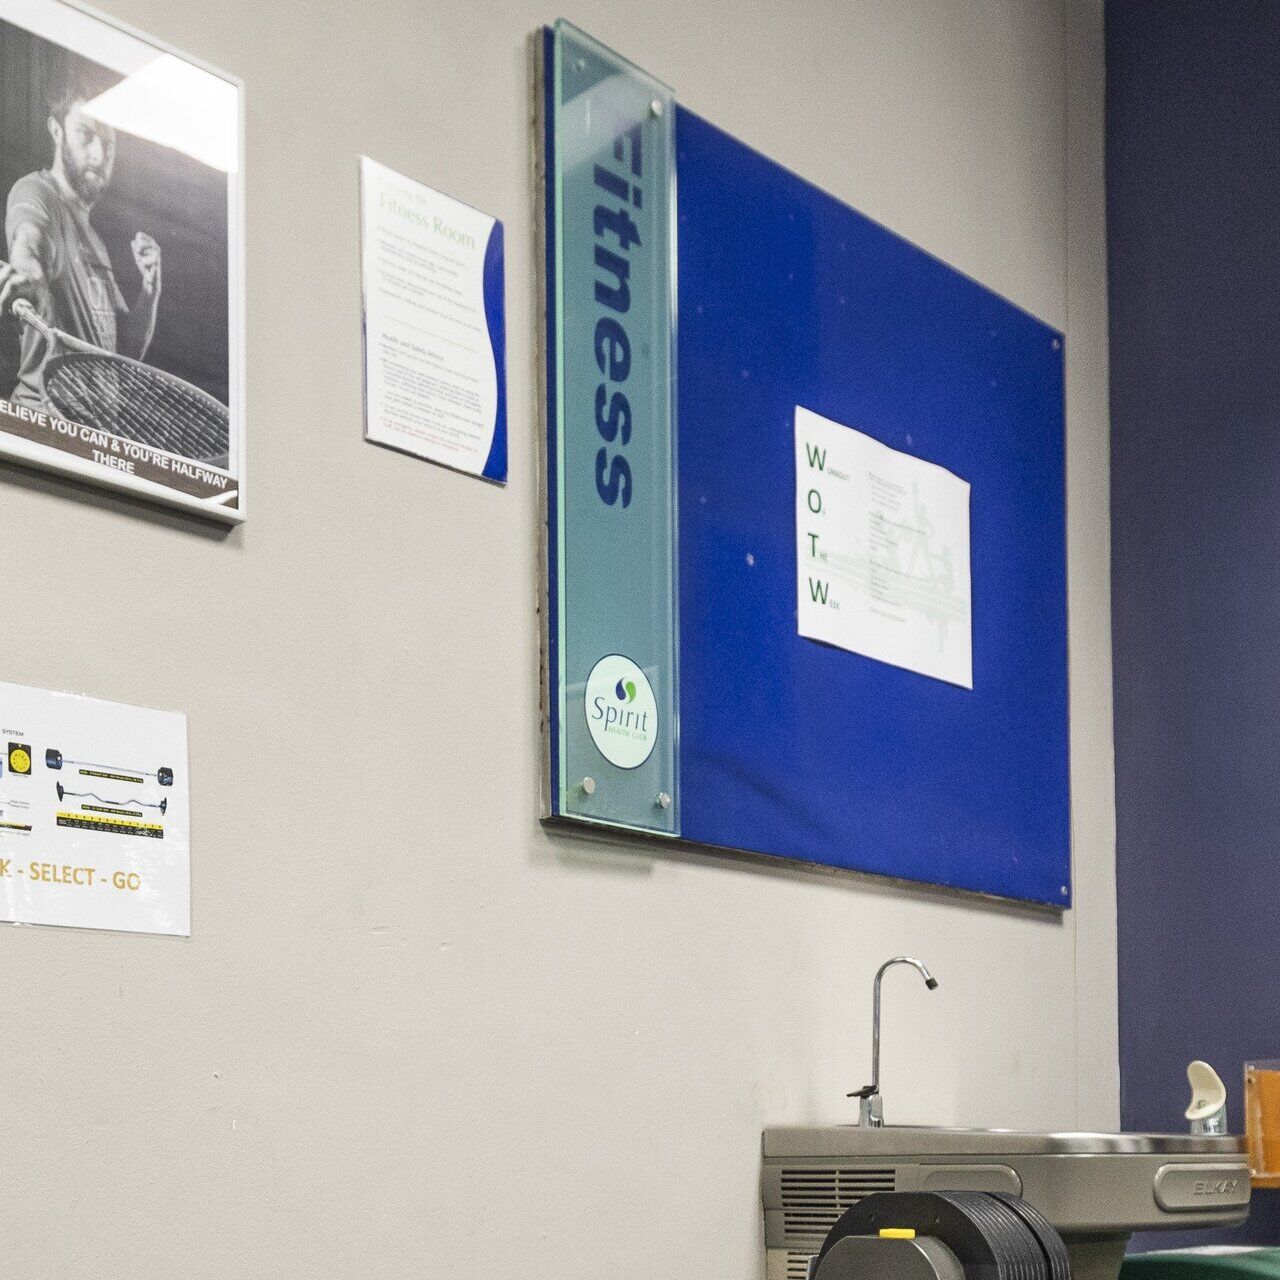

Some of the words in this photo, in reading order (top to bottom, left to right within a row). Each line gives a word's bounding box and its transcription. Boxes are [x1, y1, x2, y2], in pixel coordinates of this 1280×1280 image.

[433, 216, 476, 250] Room
[593, 121, 643, 509] Fitness
[49, 416, 77, 438] YOU
[80, 428, 108, 448] CAN
[111, 440, 120, 453] &
[123, 442, 169, 470] YOU'RE
[171, 459, 228, 489] HALFWAY
[92, 450, 135, 474] THERE
[592, 696, 648, 732] Spirit
[29, 861, 96, 886] SELECT
[112, 871, 141, 891] GO
